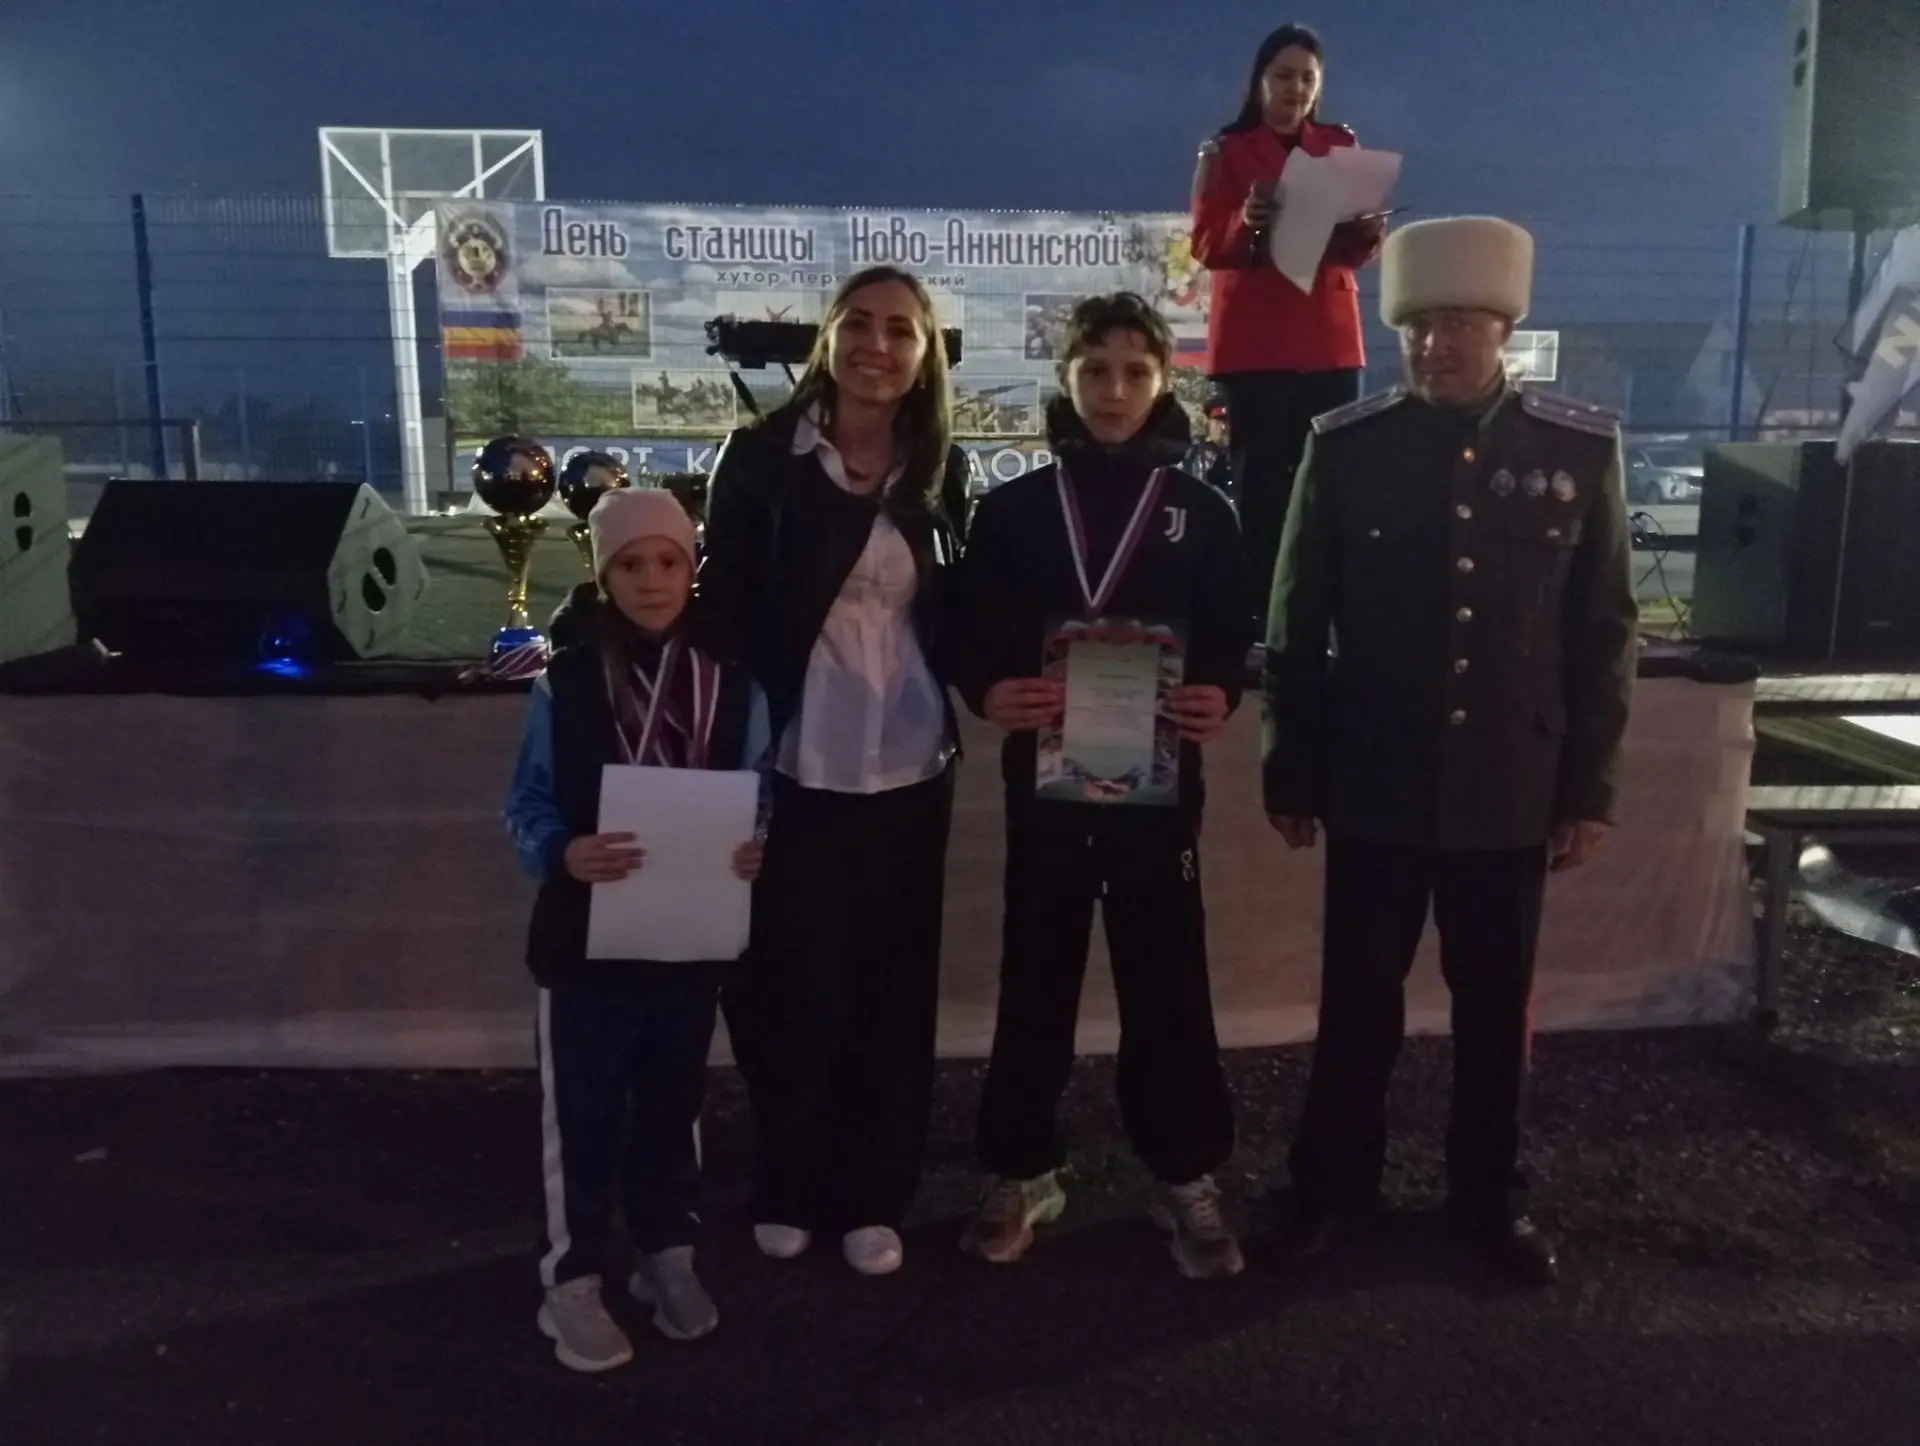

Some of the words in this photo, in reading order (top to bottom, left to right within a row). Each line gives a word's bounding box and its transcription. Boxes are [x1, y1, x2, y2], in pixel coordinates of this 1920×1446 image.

[542, 207, 628, 257] День
[665, 225, 814, 262] станицы
[716, 271, 780, 287] хутор
